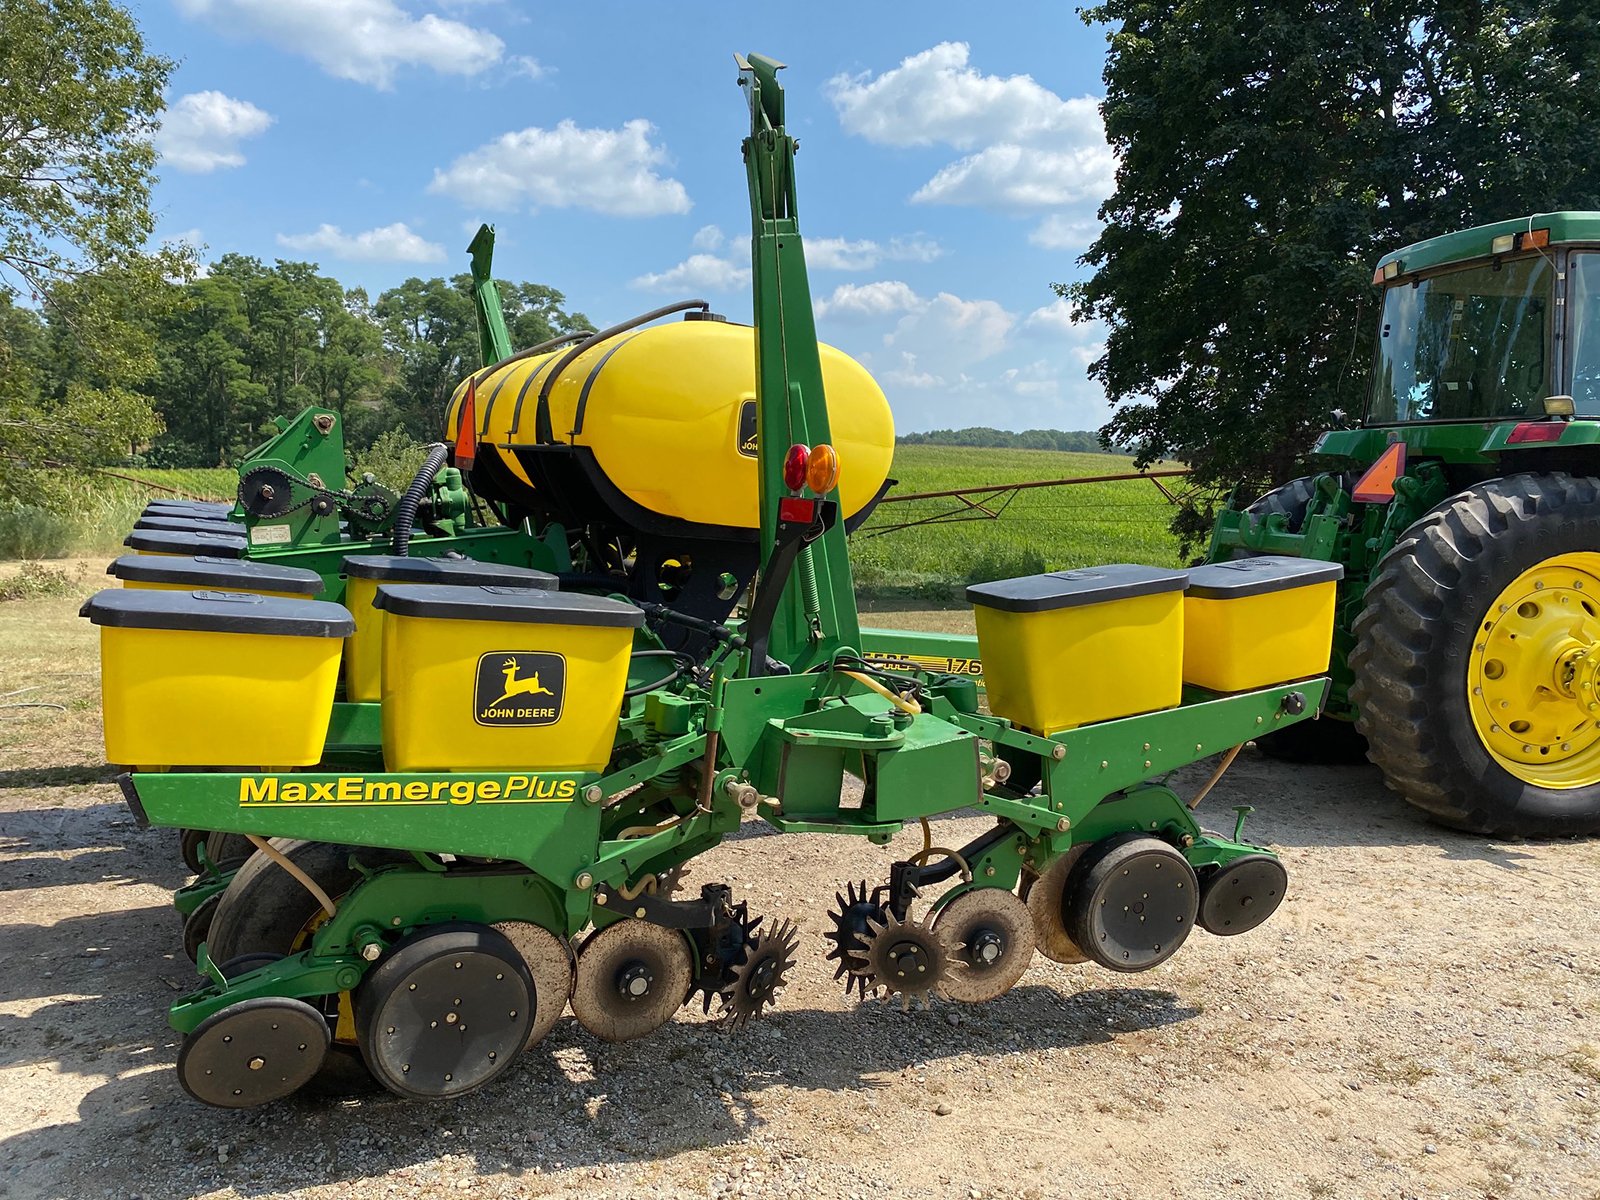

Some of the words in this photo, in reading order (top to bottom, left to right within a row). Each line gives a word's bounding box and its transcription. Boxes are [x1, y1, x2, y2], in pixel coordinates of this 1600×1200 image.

[741, 442, 758, 450] JOH
[946, 658, 982, 675] 176
[480, 708, 514, 718] JOHN
[516, 708, 556, 718] DEERE
